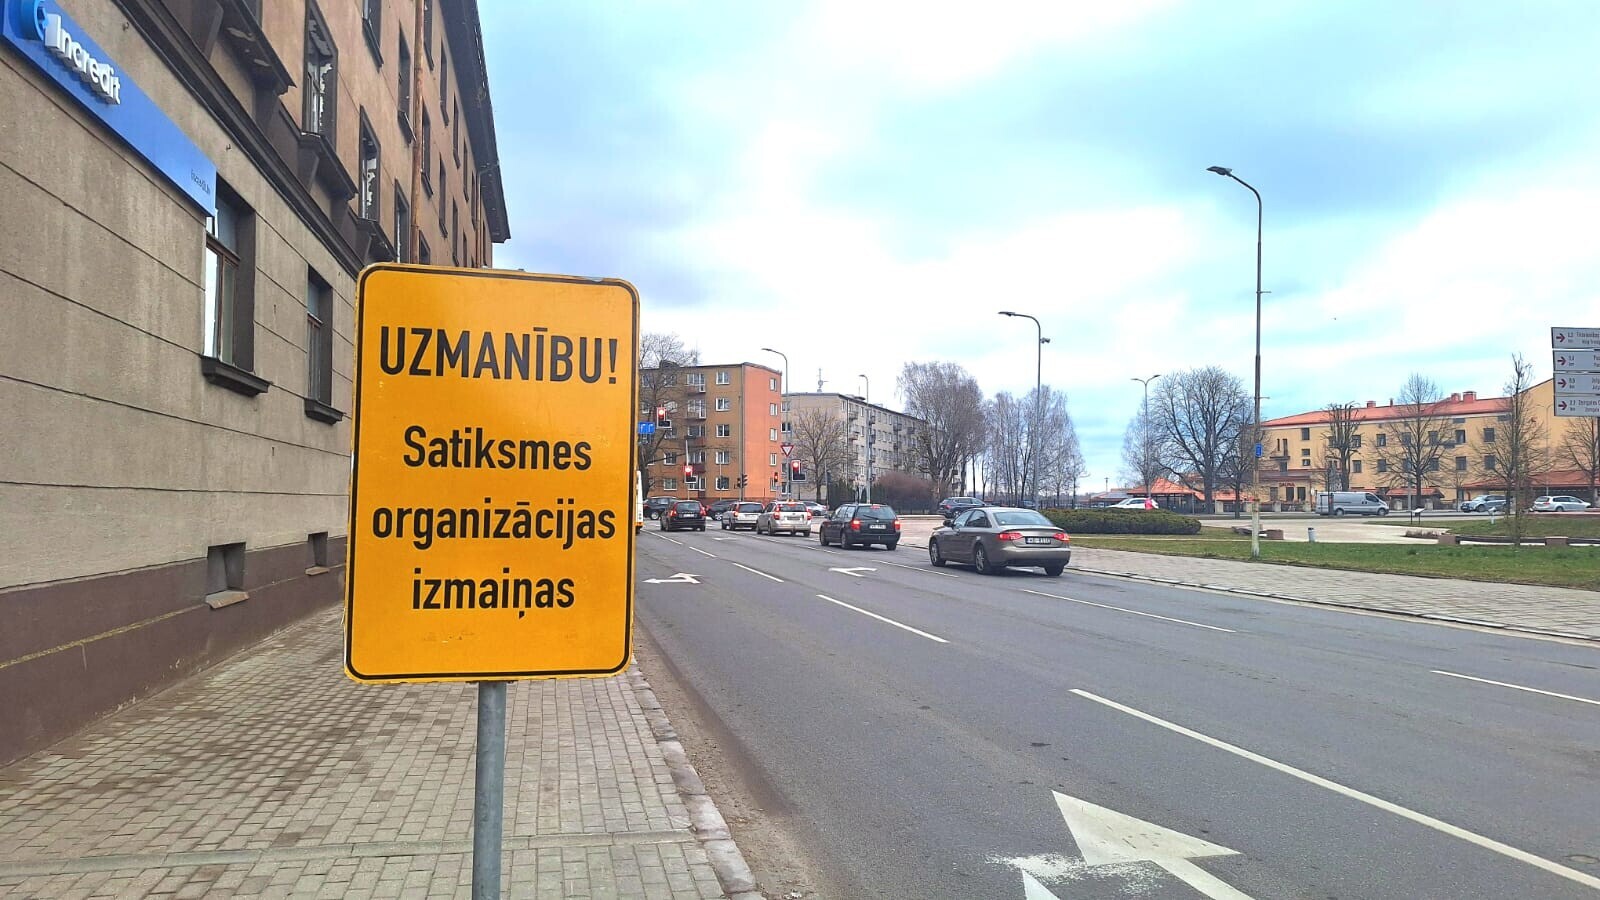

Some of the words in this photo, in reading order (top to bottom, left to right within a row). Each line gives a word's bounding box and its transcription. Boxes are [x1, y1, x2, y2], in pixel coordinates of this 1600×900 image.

[45, 13, 121, 105] Incredit
[379, 325, 618, 385] UZMANĪBU!
[403, 425, 592, 471] Satiksmes
[372, 496, 616, 551] organizācijas
[412, 567, 575, 620] izmaiņas
